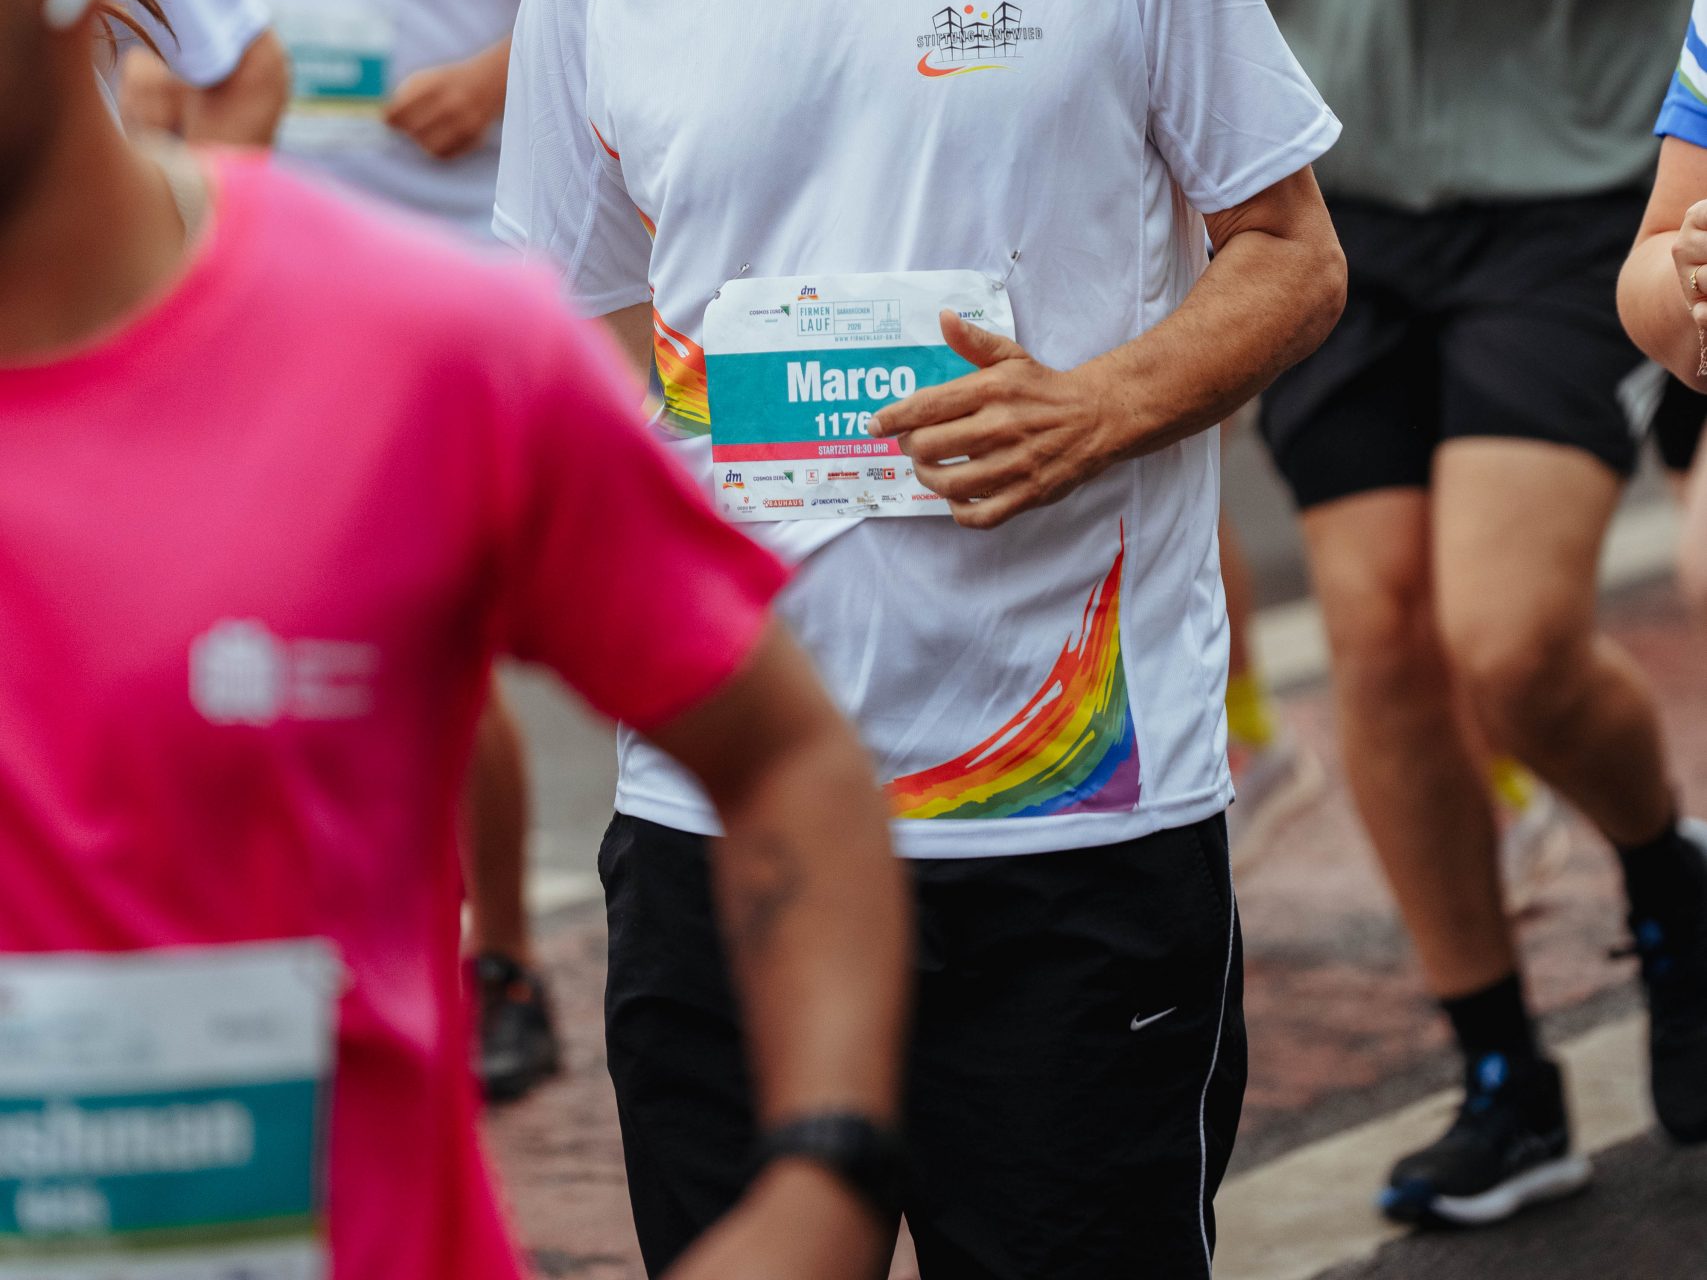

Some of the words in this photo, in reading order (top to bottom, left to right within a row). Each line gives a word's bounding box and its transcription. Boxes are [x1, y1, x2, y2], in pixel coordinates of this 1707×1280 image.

[916, 30, 976, 48] STIFTUNG
[801, 285, 817, 296] dm
[800, 307, 830, 317] FIRMEN
[800, 318, 830, 332] LAUF
[787, 360, 916, 403] Marco
[815, 411, 873, 436] 1176
[818, 445, 852, 456] STARTZEIT
[853, 444, 872, 455] 18:30
[873, 443, 889, 454] UHR
[725, 469, 742, 483] dm
[769, 499, 803, 507] BAUHAUS
